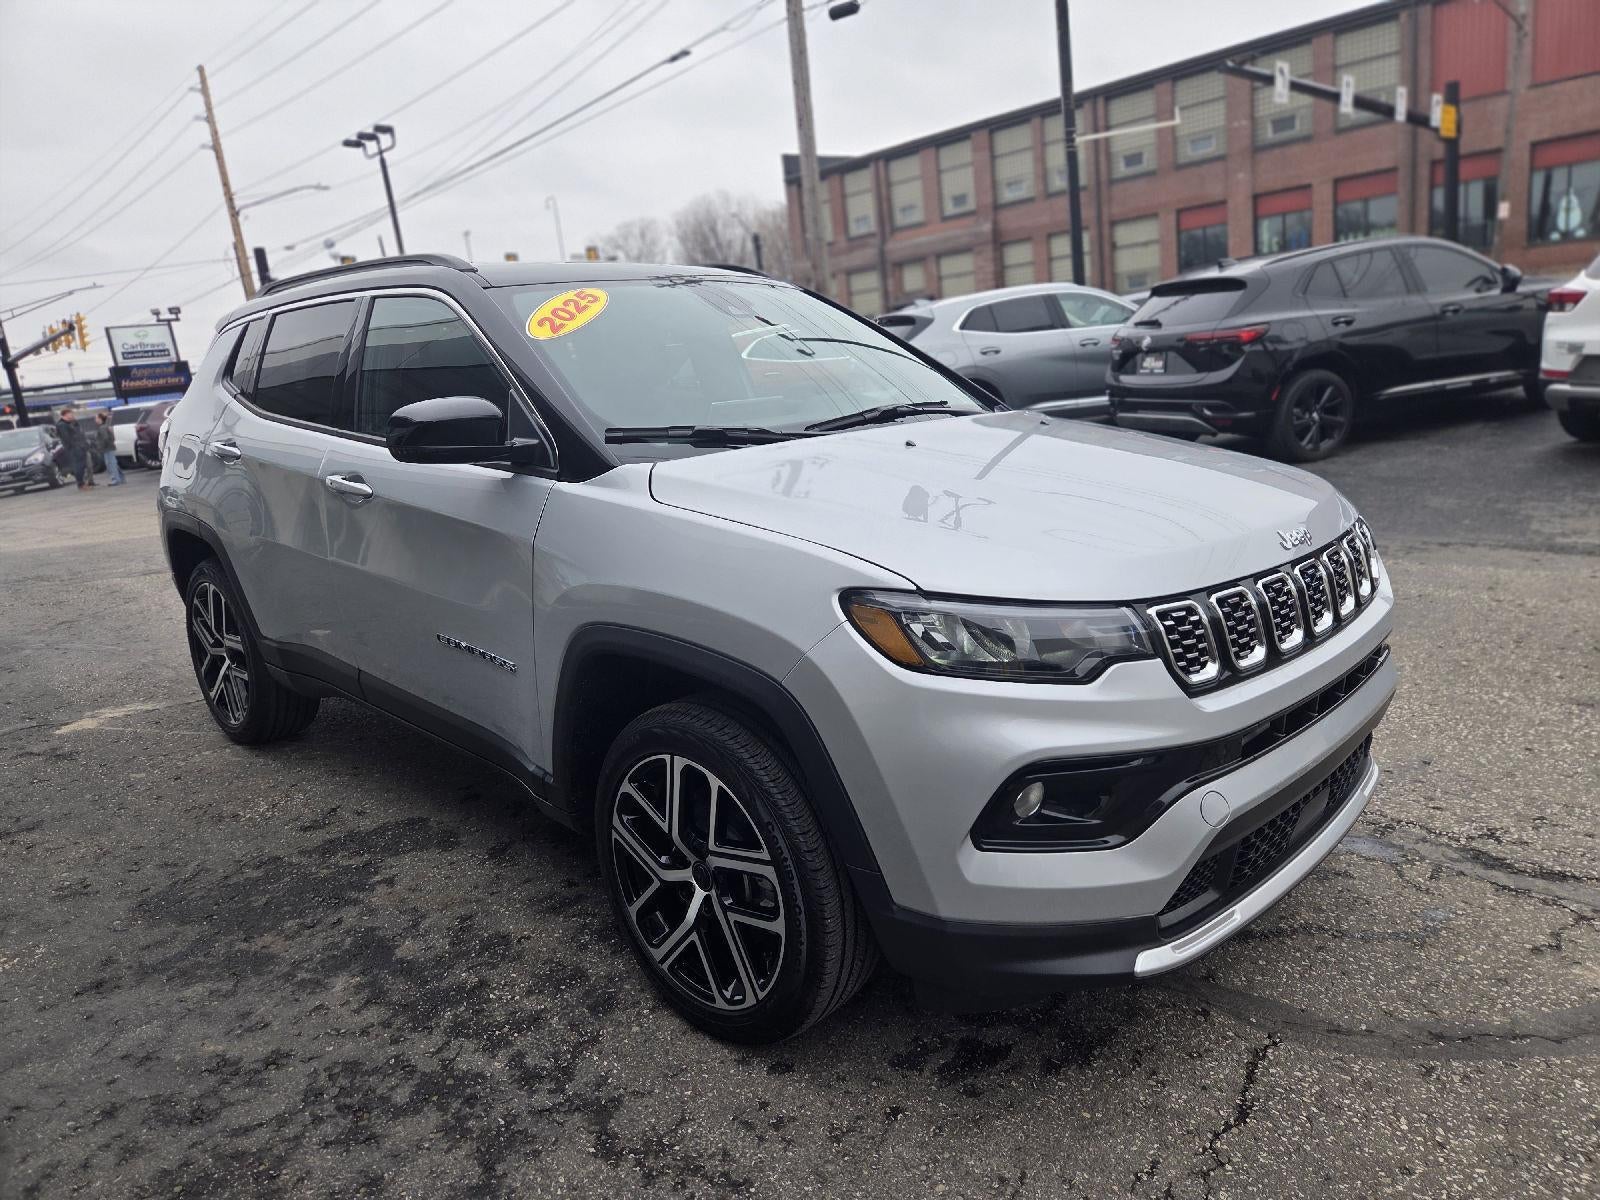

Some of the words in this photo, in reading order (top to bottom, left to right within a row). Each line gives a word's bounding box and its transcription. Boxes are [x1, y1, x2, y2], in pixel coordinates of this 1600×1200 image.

[537, 290, 600, 334] 2025
[122, 342, 166, 351] CarBravo
[121, 377, 185, 389] Headquarters
[1276, 527, 1313, 551] Jeep
[436, 633, 518, 673] COMPASS
